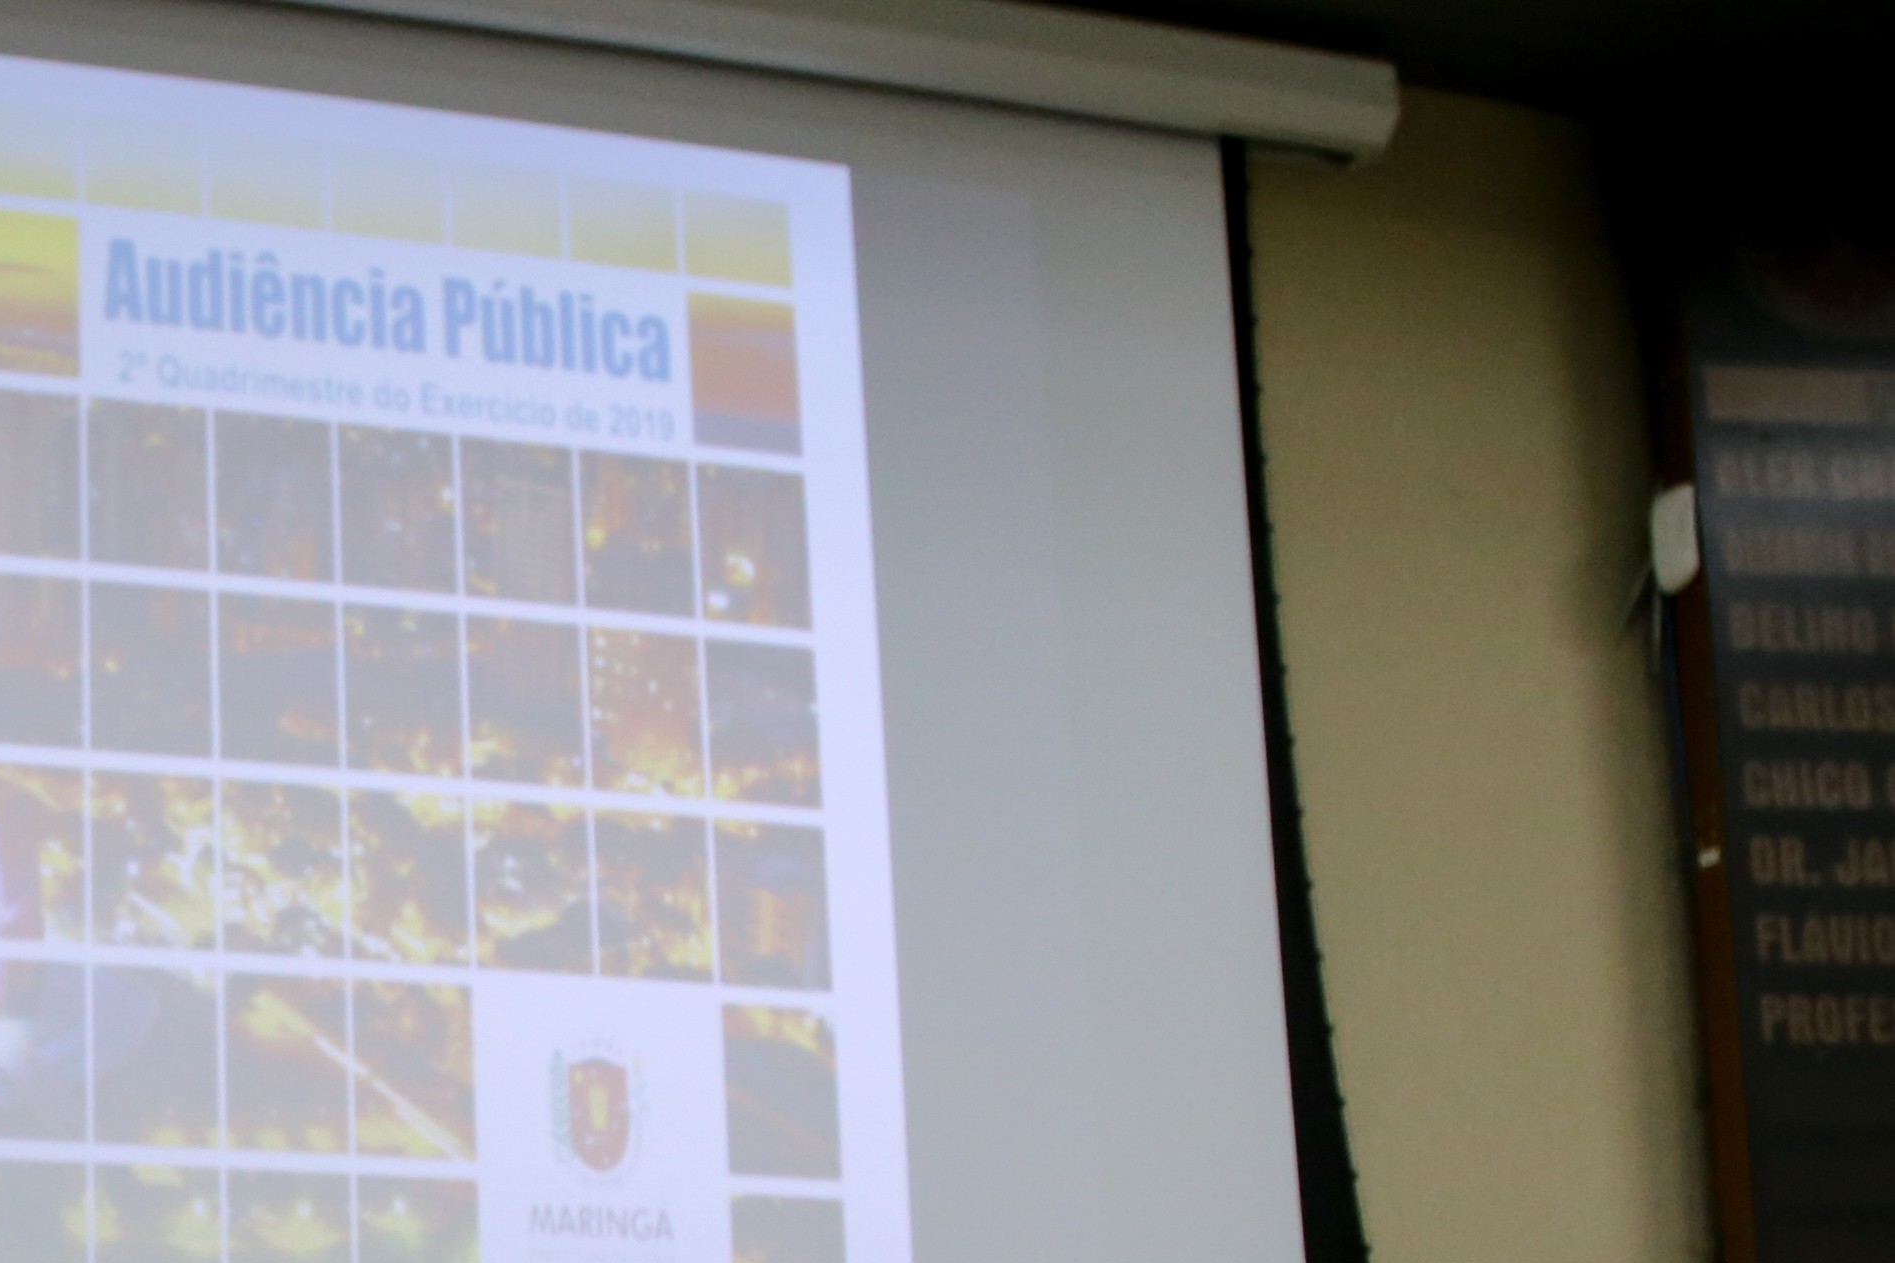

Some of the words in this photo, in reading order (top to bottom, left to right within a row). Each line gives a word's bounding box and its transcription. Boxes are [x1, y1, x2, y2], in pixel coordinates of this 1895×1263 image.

[104, 236, 426, 353] Audiência
[442, 275, 672, 383] Pública
[156, 352, 365, 408] Quadrimestre
[373, 380, 411, 412] do
[564, 401, 600, 434] de
[609, 402, 676, 443] 2019
[1742, 759, 1873, 811] CHICO
[1749, 833, 1822, 888] DR.
[1833, 835, 1895, 888] JA
